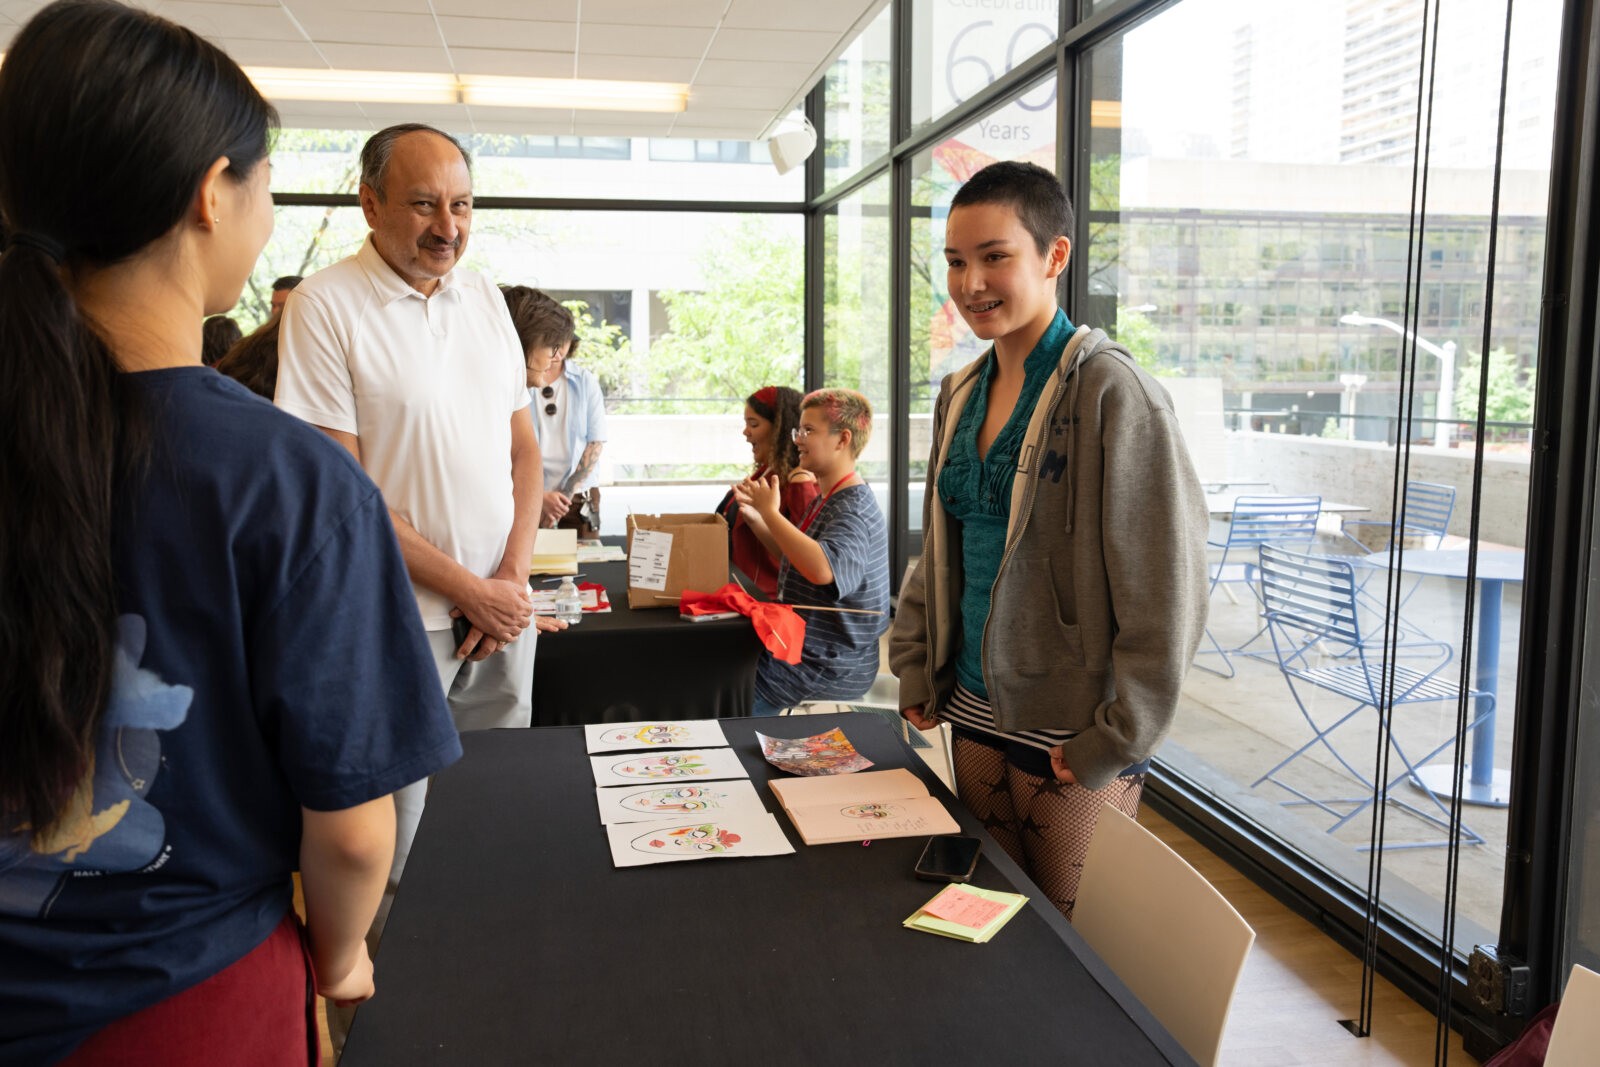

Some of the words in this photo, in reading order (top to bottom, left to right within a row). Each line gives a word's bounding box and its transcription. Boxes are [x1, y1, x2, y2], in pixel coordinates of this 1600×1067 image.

[948, 0, 1056, 13] eeratin
[946, 20, 1057, 112] 60
[978, 119, 1031, 141] Years
